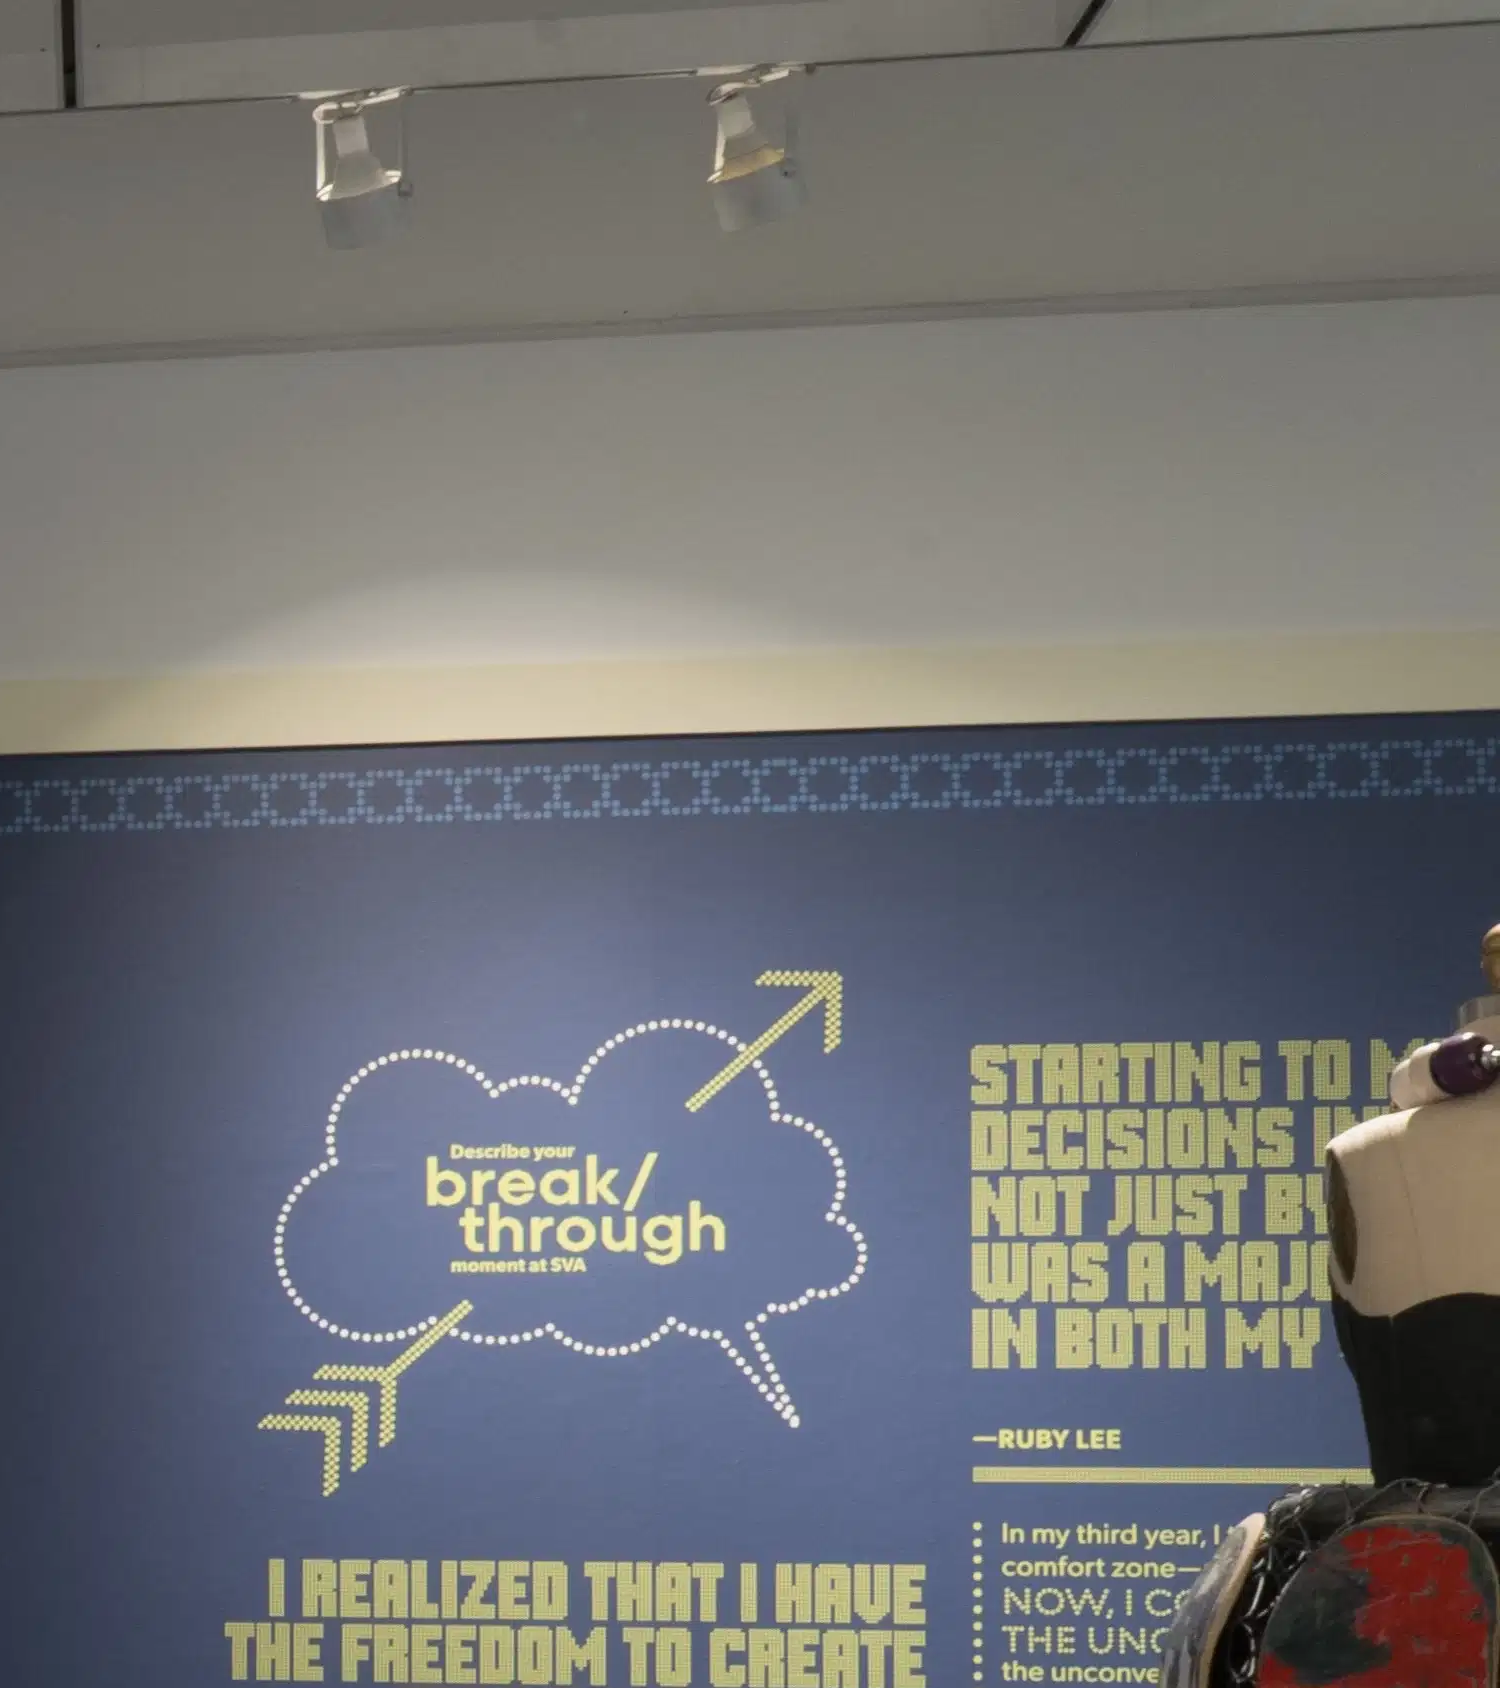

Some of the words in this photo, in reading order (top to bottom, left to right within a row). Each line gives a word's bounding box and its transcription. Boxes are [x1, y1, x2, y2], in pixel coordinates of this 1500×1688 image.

[970, 1040, 1261, 1104] STARTING
[1278, 1040, 1351, 1101] TO
[450, 1144, 529, 1159] Describe
[533, 1146, 575, 1162] your
[970, 1108, 1295, 1170] DECISIONS
[426, 1152, 658, 1211] break/
[971, 1175, 1090, 1236] NOT
[1107, 1175, 1248, 1236] JUST
[459, 1201, 726, 1265] through
[450, 1258, 525, 1274] moment
[529, 1258, 548, 1274] at
[551, 1258, 586, 1274] SVA
[971, 1243, 1109, 1302] WAS
[1127, 1242, 1165, 1302] A
[971, 1308, 1037, 1369] IN
[1055, 1308, 1207, 1369] BOTH
[1225, 1308, 1321, 1369] MY
[1076, 1429, 1121, 1450] LEE
[1002, 1522, 1025, 1544] In
[1032, 1526, 1069, 1549] my
[1077, 1523, 1137, 1545] third
[1145, 1528, 1205, 1549] year,
[1214, 1525, 1220, 1545] I
[268, 1558, 284, 1616] I
[301, 1560, 568, 1620] REALIZED
[584, 1561, 724, 1622] THAT
[740, 1562, 757, 1623] I
[775, 1563, 926, 1624] HAVE
[1002, 1557, 1105, 1578] comfort
[1004, 1588, 1114, 1619] NOW,
[1126, 1589, 1133, 1616] I
[224, 1623, 324, 1682] THE
[341, 1625, 607, 1685] FREEDOM
[623, 1627, 692, 1687] TO
[1001, 1626, 1076, 1654] THE
[1002, 1661, 1044, 1683] the
